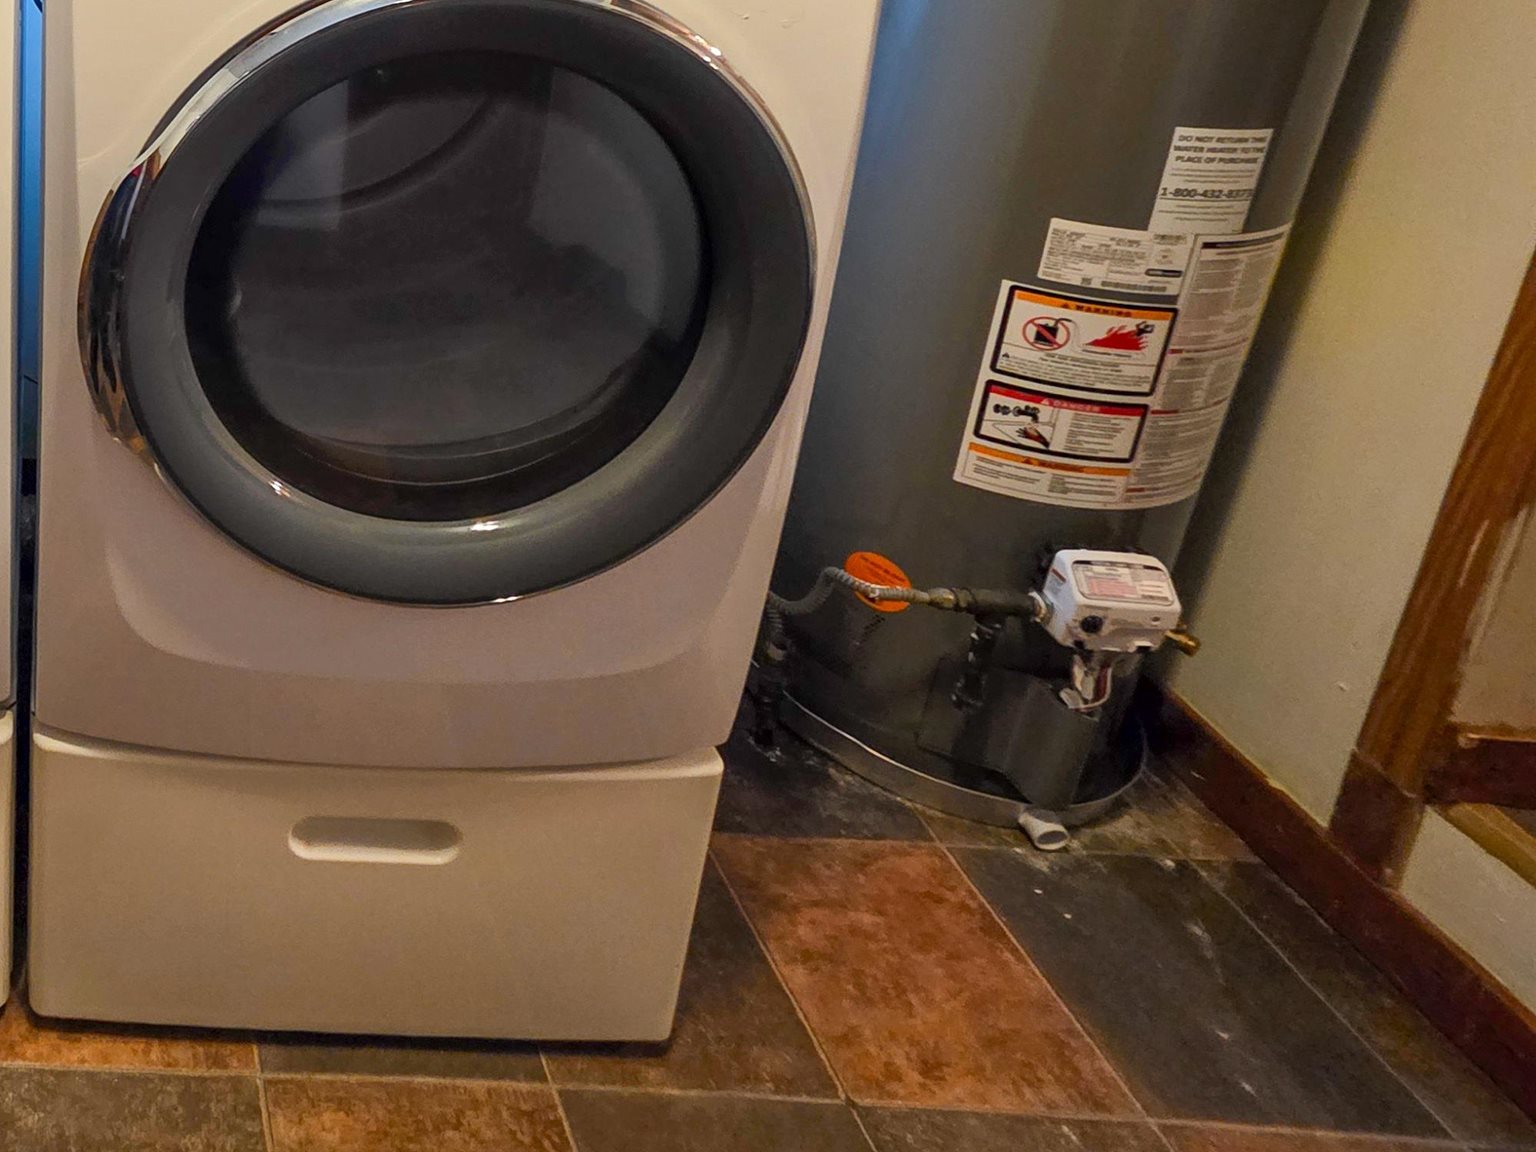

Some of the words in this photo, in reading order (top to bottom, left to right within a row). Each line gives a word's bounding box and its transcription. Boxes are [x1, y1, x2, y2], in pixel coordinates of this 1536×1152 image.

[1178, 134, 1193, 142] DO
[1194, 135, 1214, 143] NOT
[1173, 144, 1205, 153] WATER
[1175, 155, 1202, 164] PLACE
[1203, 156, 1217, 164] OF
[1055, 399, 1101, 413] DANGER
